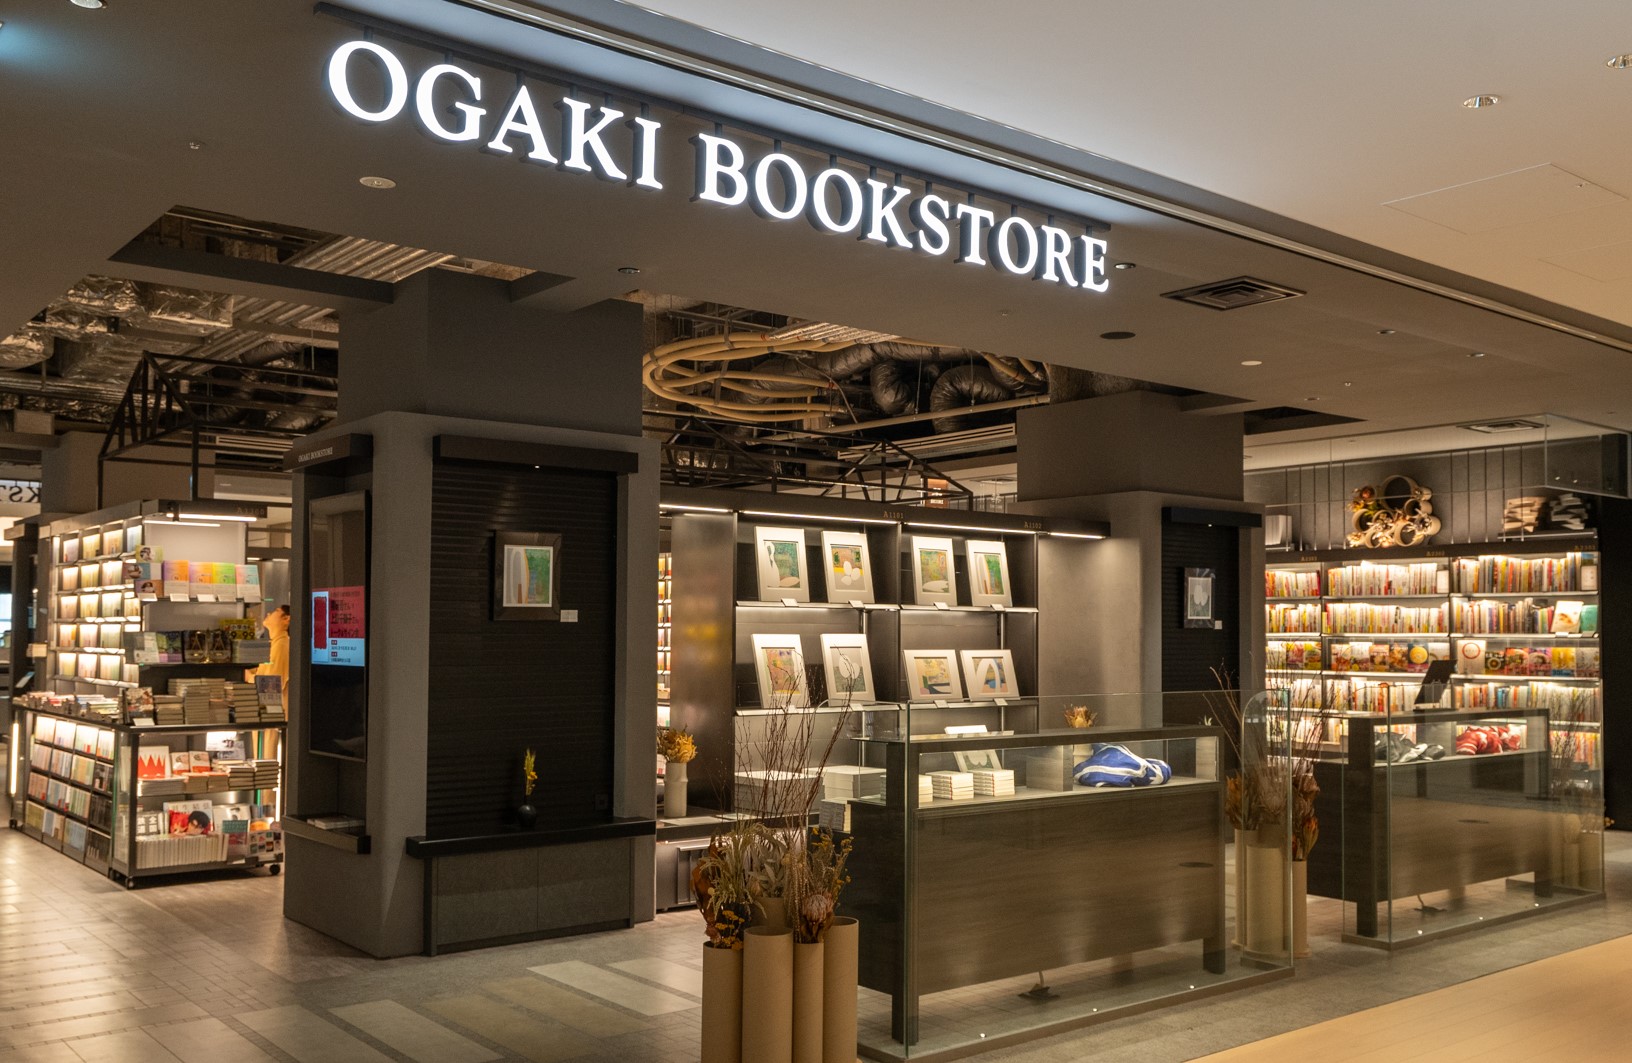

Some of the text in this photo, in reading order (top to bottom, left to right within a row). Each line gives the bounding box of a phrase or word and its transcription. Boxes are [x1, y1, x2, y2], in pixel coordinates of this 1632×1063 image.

[328, 40, 1110, 293] OGAKI BOOKSTORE
[883, 510, 904, 519] A1101
[1024, 521, 1042, 529] A1102
